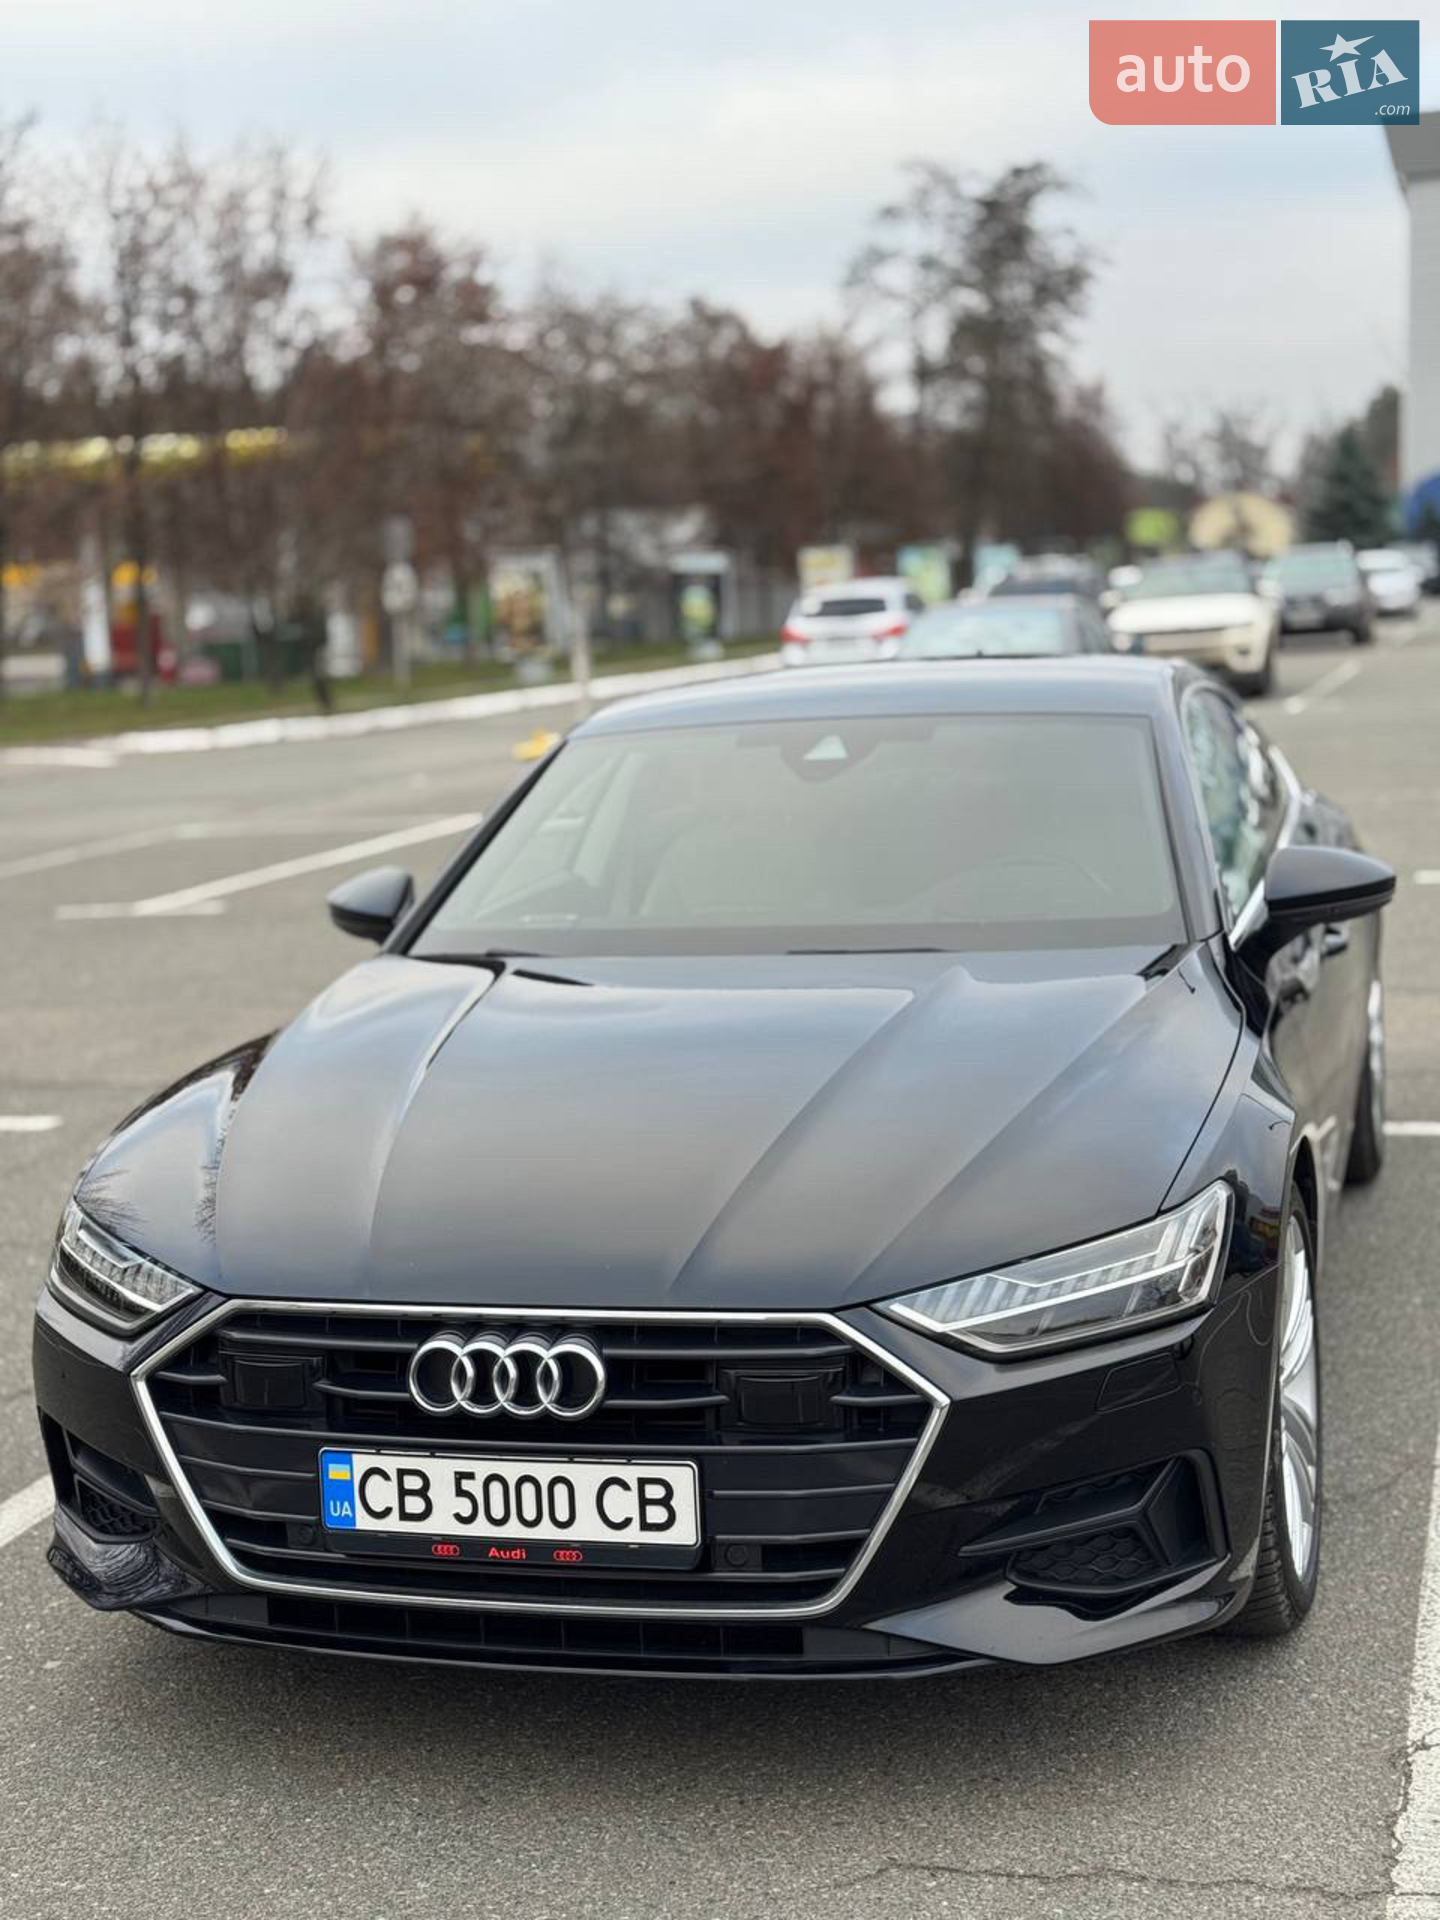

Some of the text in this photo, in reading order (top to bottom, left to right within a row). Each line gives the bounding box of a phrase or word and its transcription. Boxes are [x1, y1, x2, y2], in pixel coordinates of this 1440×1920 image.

[358, 1466, 677, 1532] CB 5000 CB
[330, 1500, 353, 1518] UA
[488, 1547, 527, 1560] Audi
